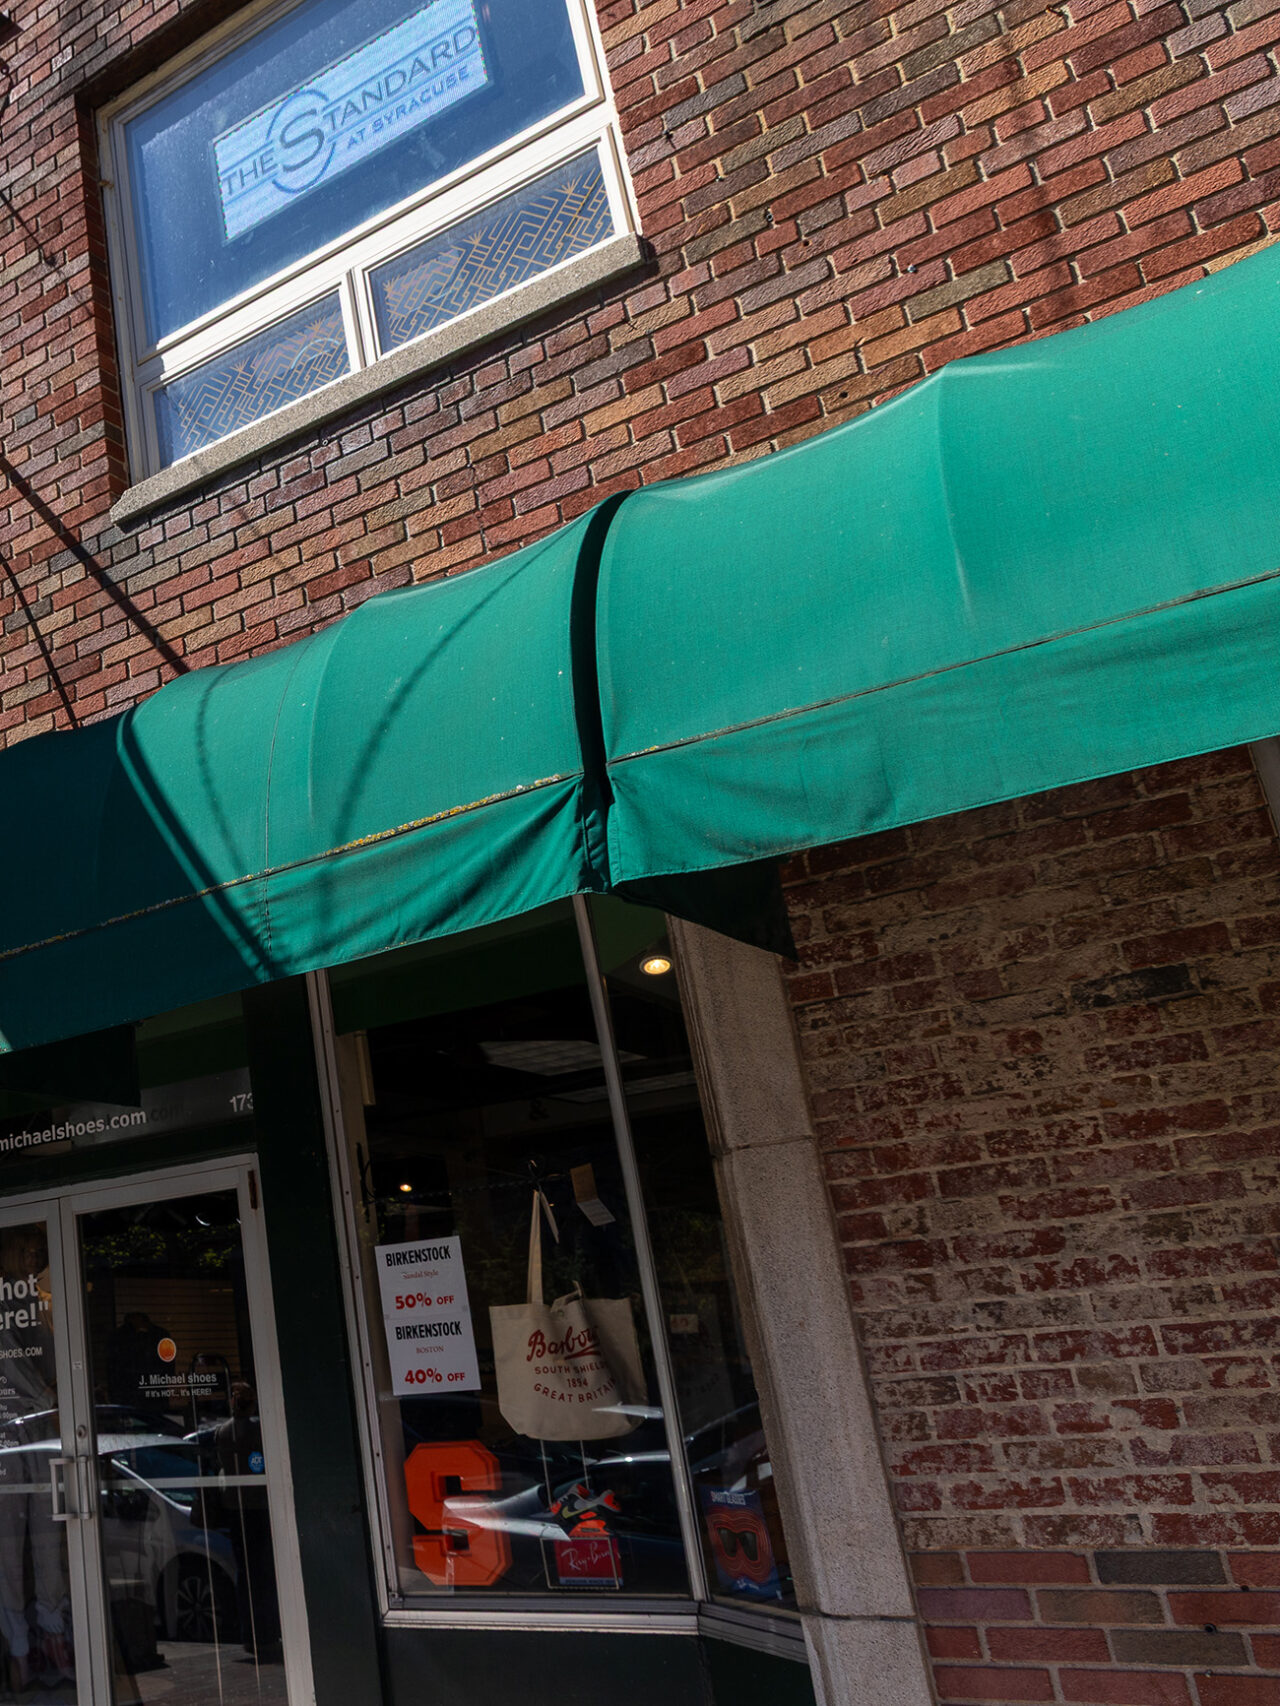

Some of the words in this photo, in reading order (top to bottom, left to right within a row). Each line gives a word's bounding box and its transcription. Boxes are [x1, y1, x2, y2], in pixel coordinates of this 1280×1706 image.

[221, 147, 278, 195] THE
[278, 24, 477, 173] STANDARD
[346, 130, 366, 149] AT
[372, 65, 470, 134] SYRACUSE
[385, 1245, 452, 1267] BIRKENSTOCK
[395, 1292, 432, 1310] 50%
[436, 1295, 455, 1305] OFF
[395, 1321, 462, 1340] BIRKENSTOCK
[415, 1345, 445, 1354] BOSTON
[139, 1375, 148, 1385] J.
[149, 1373, 186, 1385] Michael
[187, 1372, 218, 1384] shoes
[405, 1368, 442, 1384] 40%
[447, 1372, 466, 1382] OFF
[534, 1365, 571, 1375] SOUTH
[534, 1383, 574, 1403] GREAT
[404, 1439, 514, 1586] S
